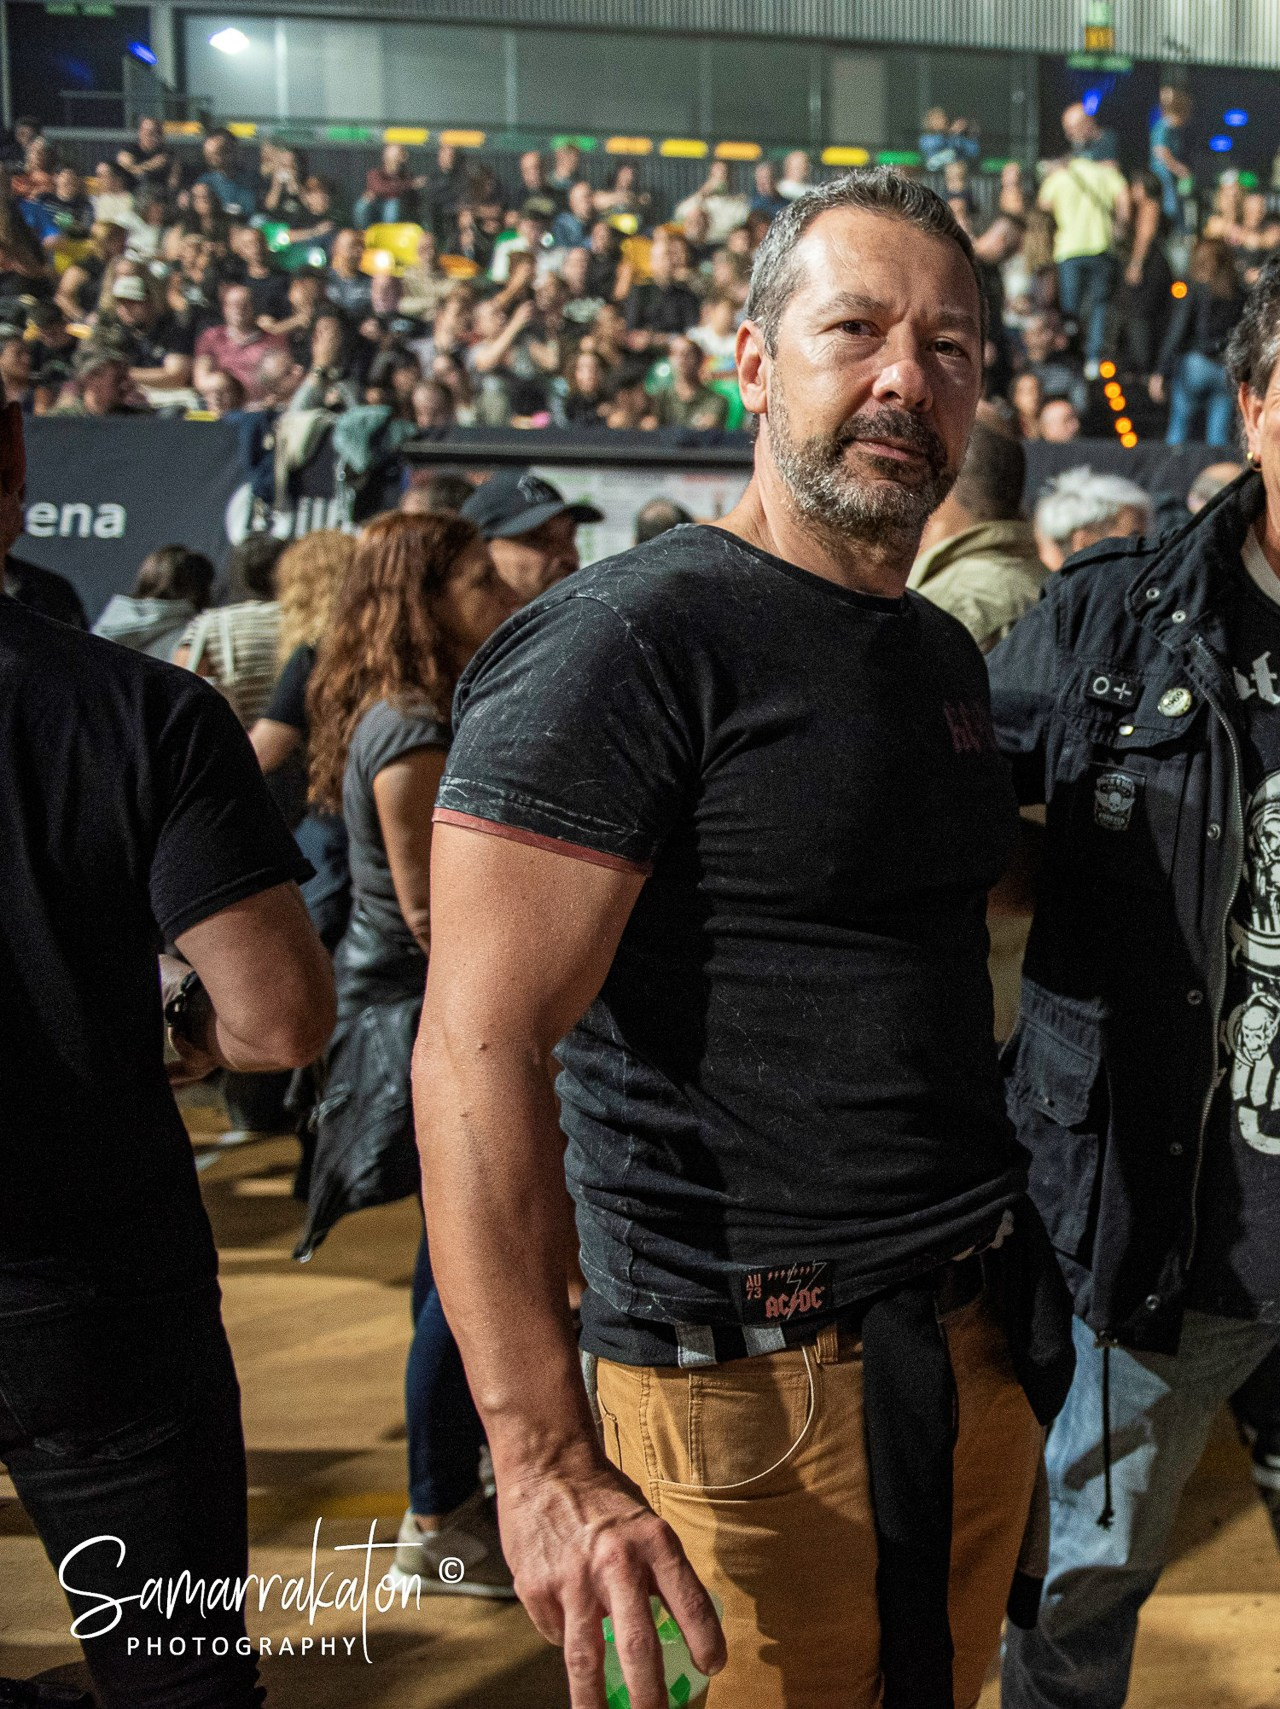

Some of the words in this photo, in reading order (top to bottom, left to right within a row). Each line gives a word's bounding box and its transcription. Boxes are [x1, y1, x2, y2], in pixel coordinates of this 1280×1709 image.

[24, 501, 127, 539] ena
[746, 1273, 762, 1288] AU
[746, 1287, 762, 1300] 73
[765, 1286, 826, 1320] AC/DC
